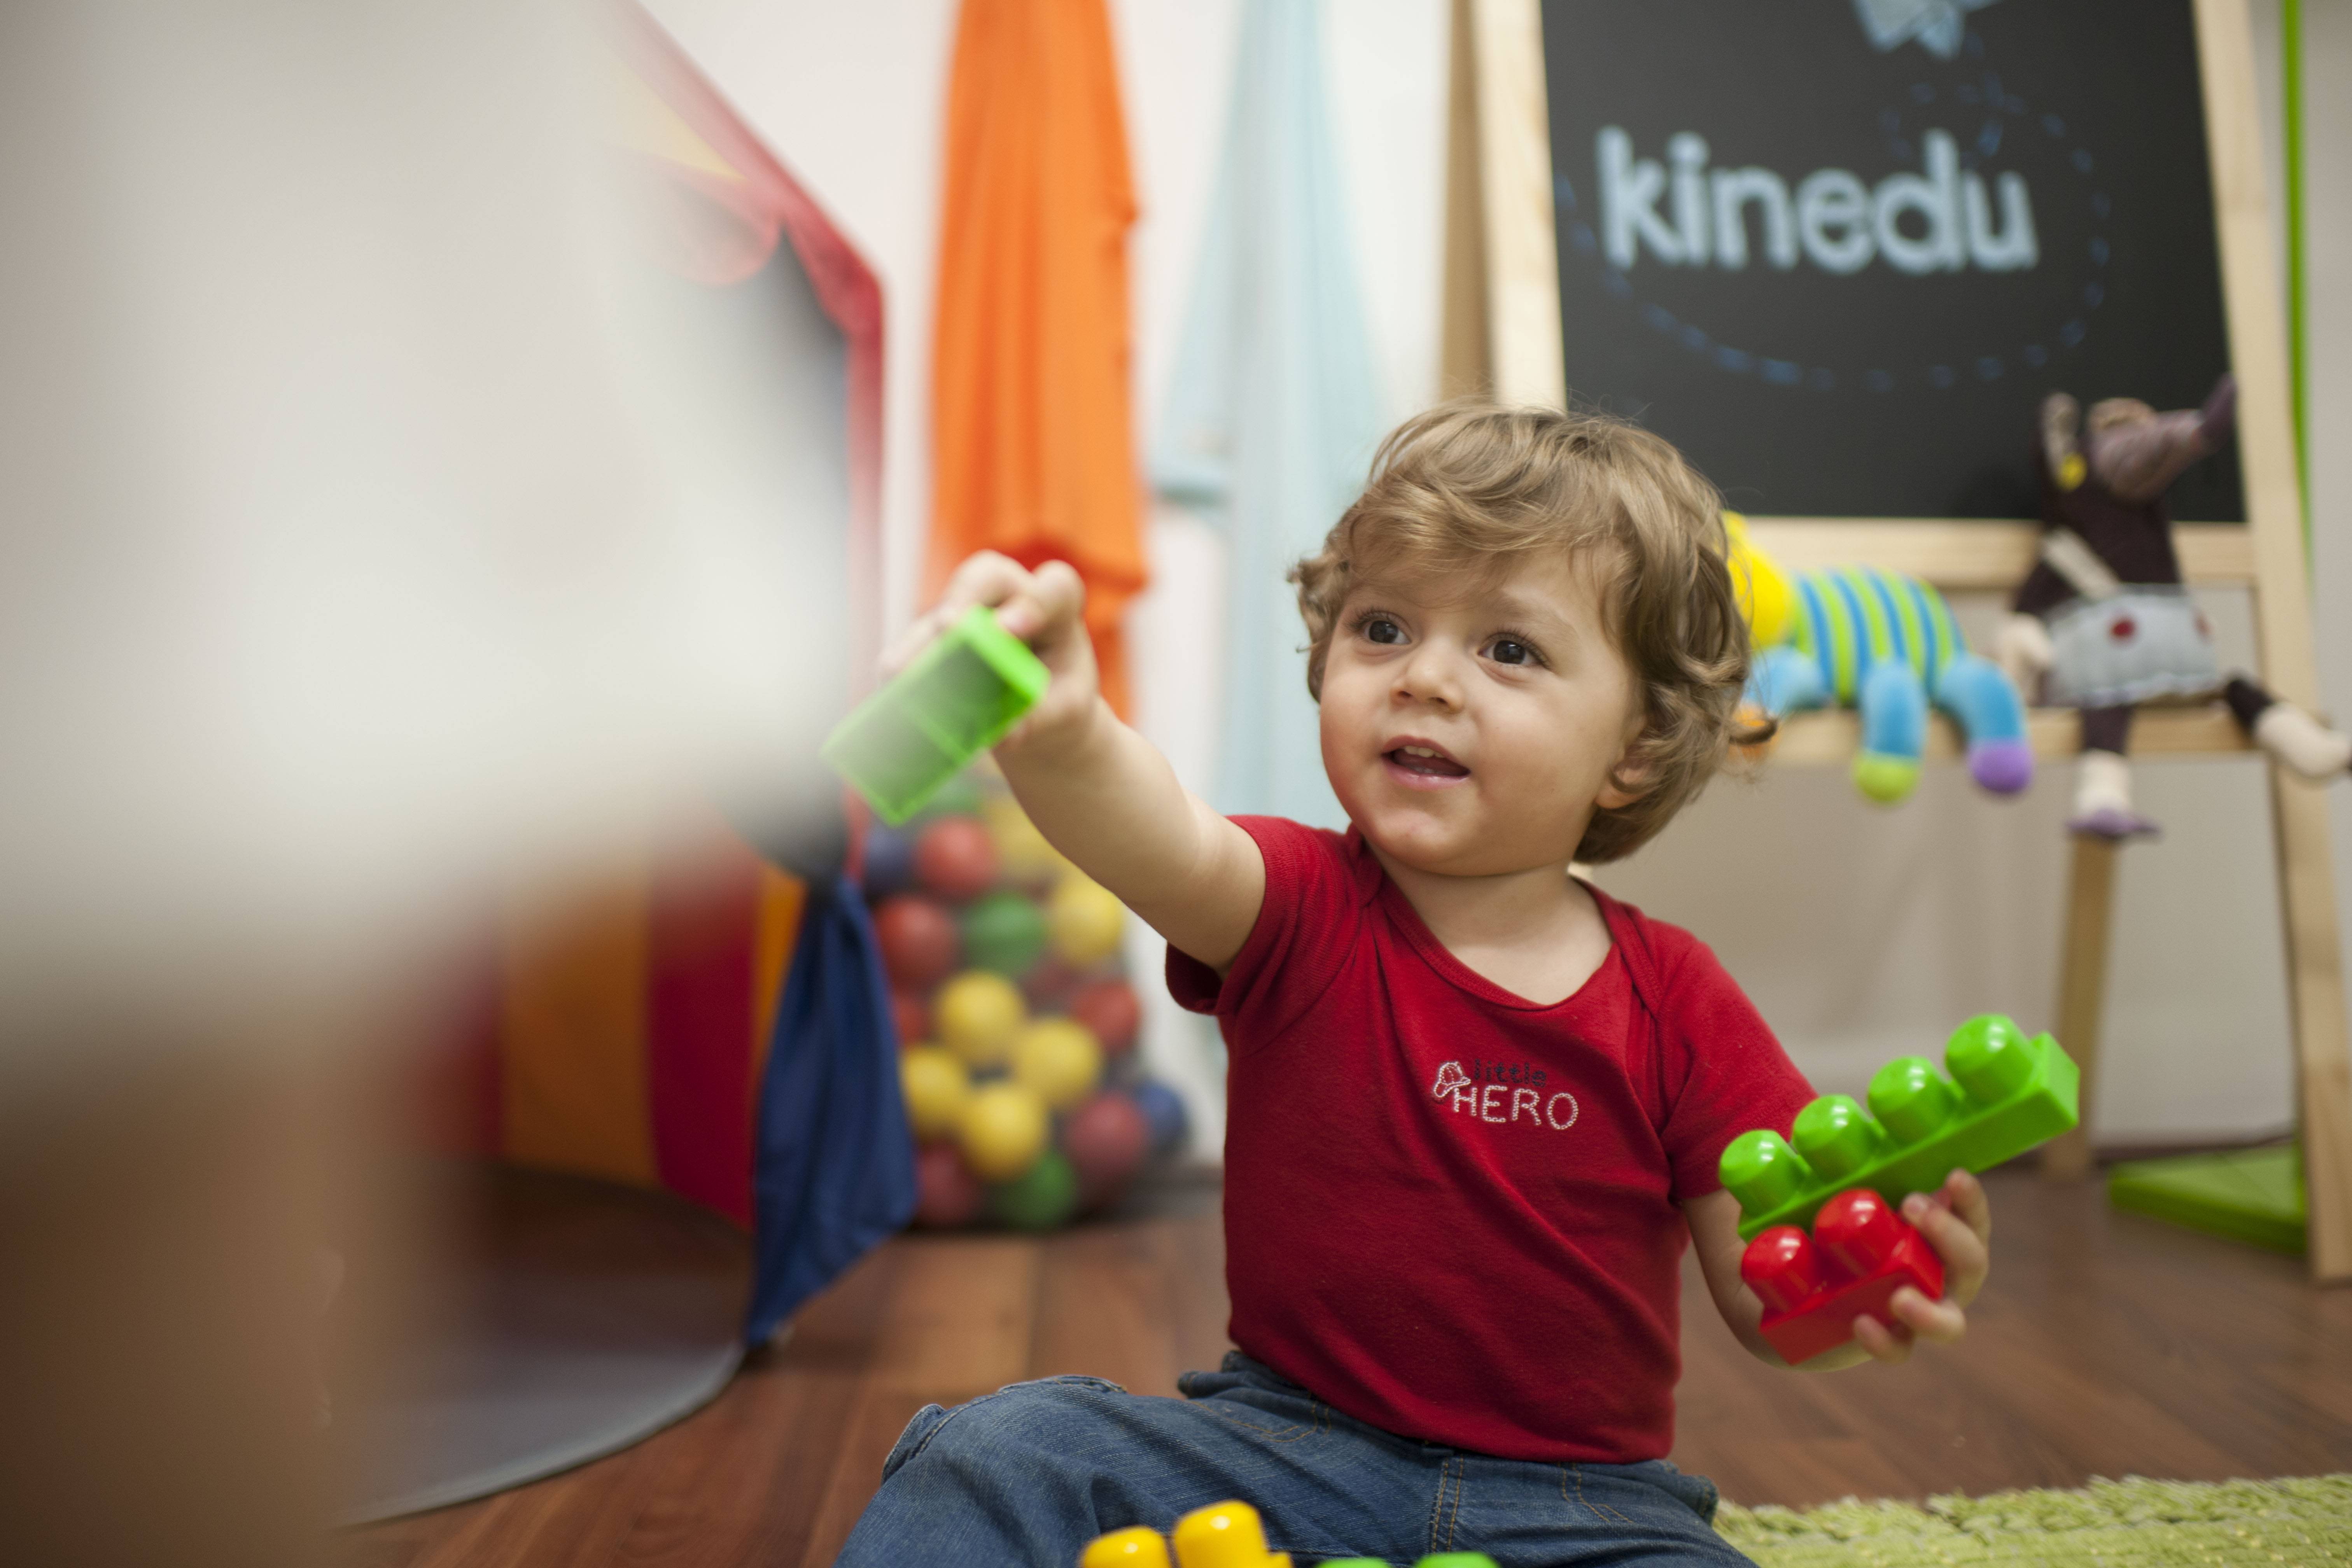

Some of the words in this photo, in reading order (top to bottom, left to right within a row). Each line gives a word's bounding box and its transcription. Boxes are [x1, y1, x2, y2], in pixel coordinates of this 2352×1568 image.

[1596, 126, 2037, 274] kinedu
[1474, 1059, 1547, 1087] little
[1453, 1085, 1579, 1130] HERO
